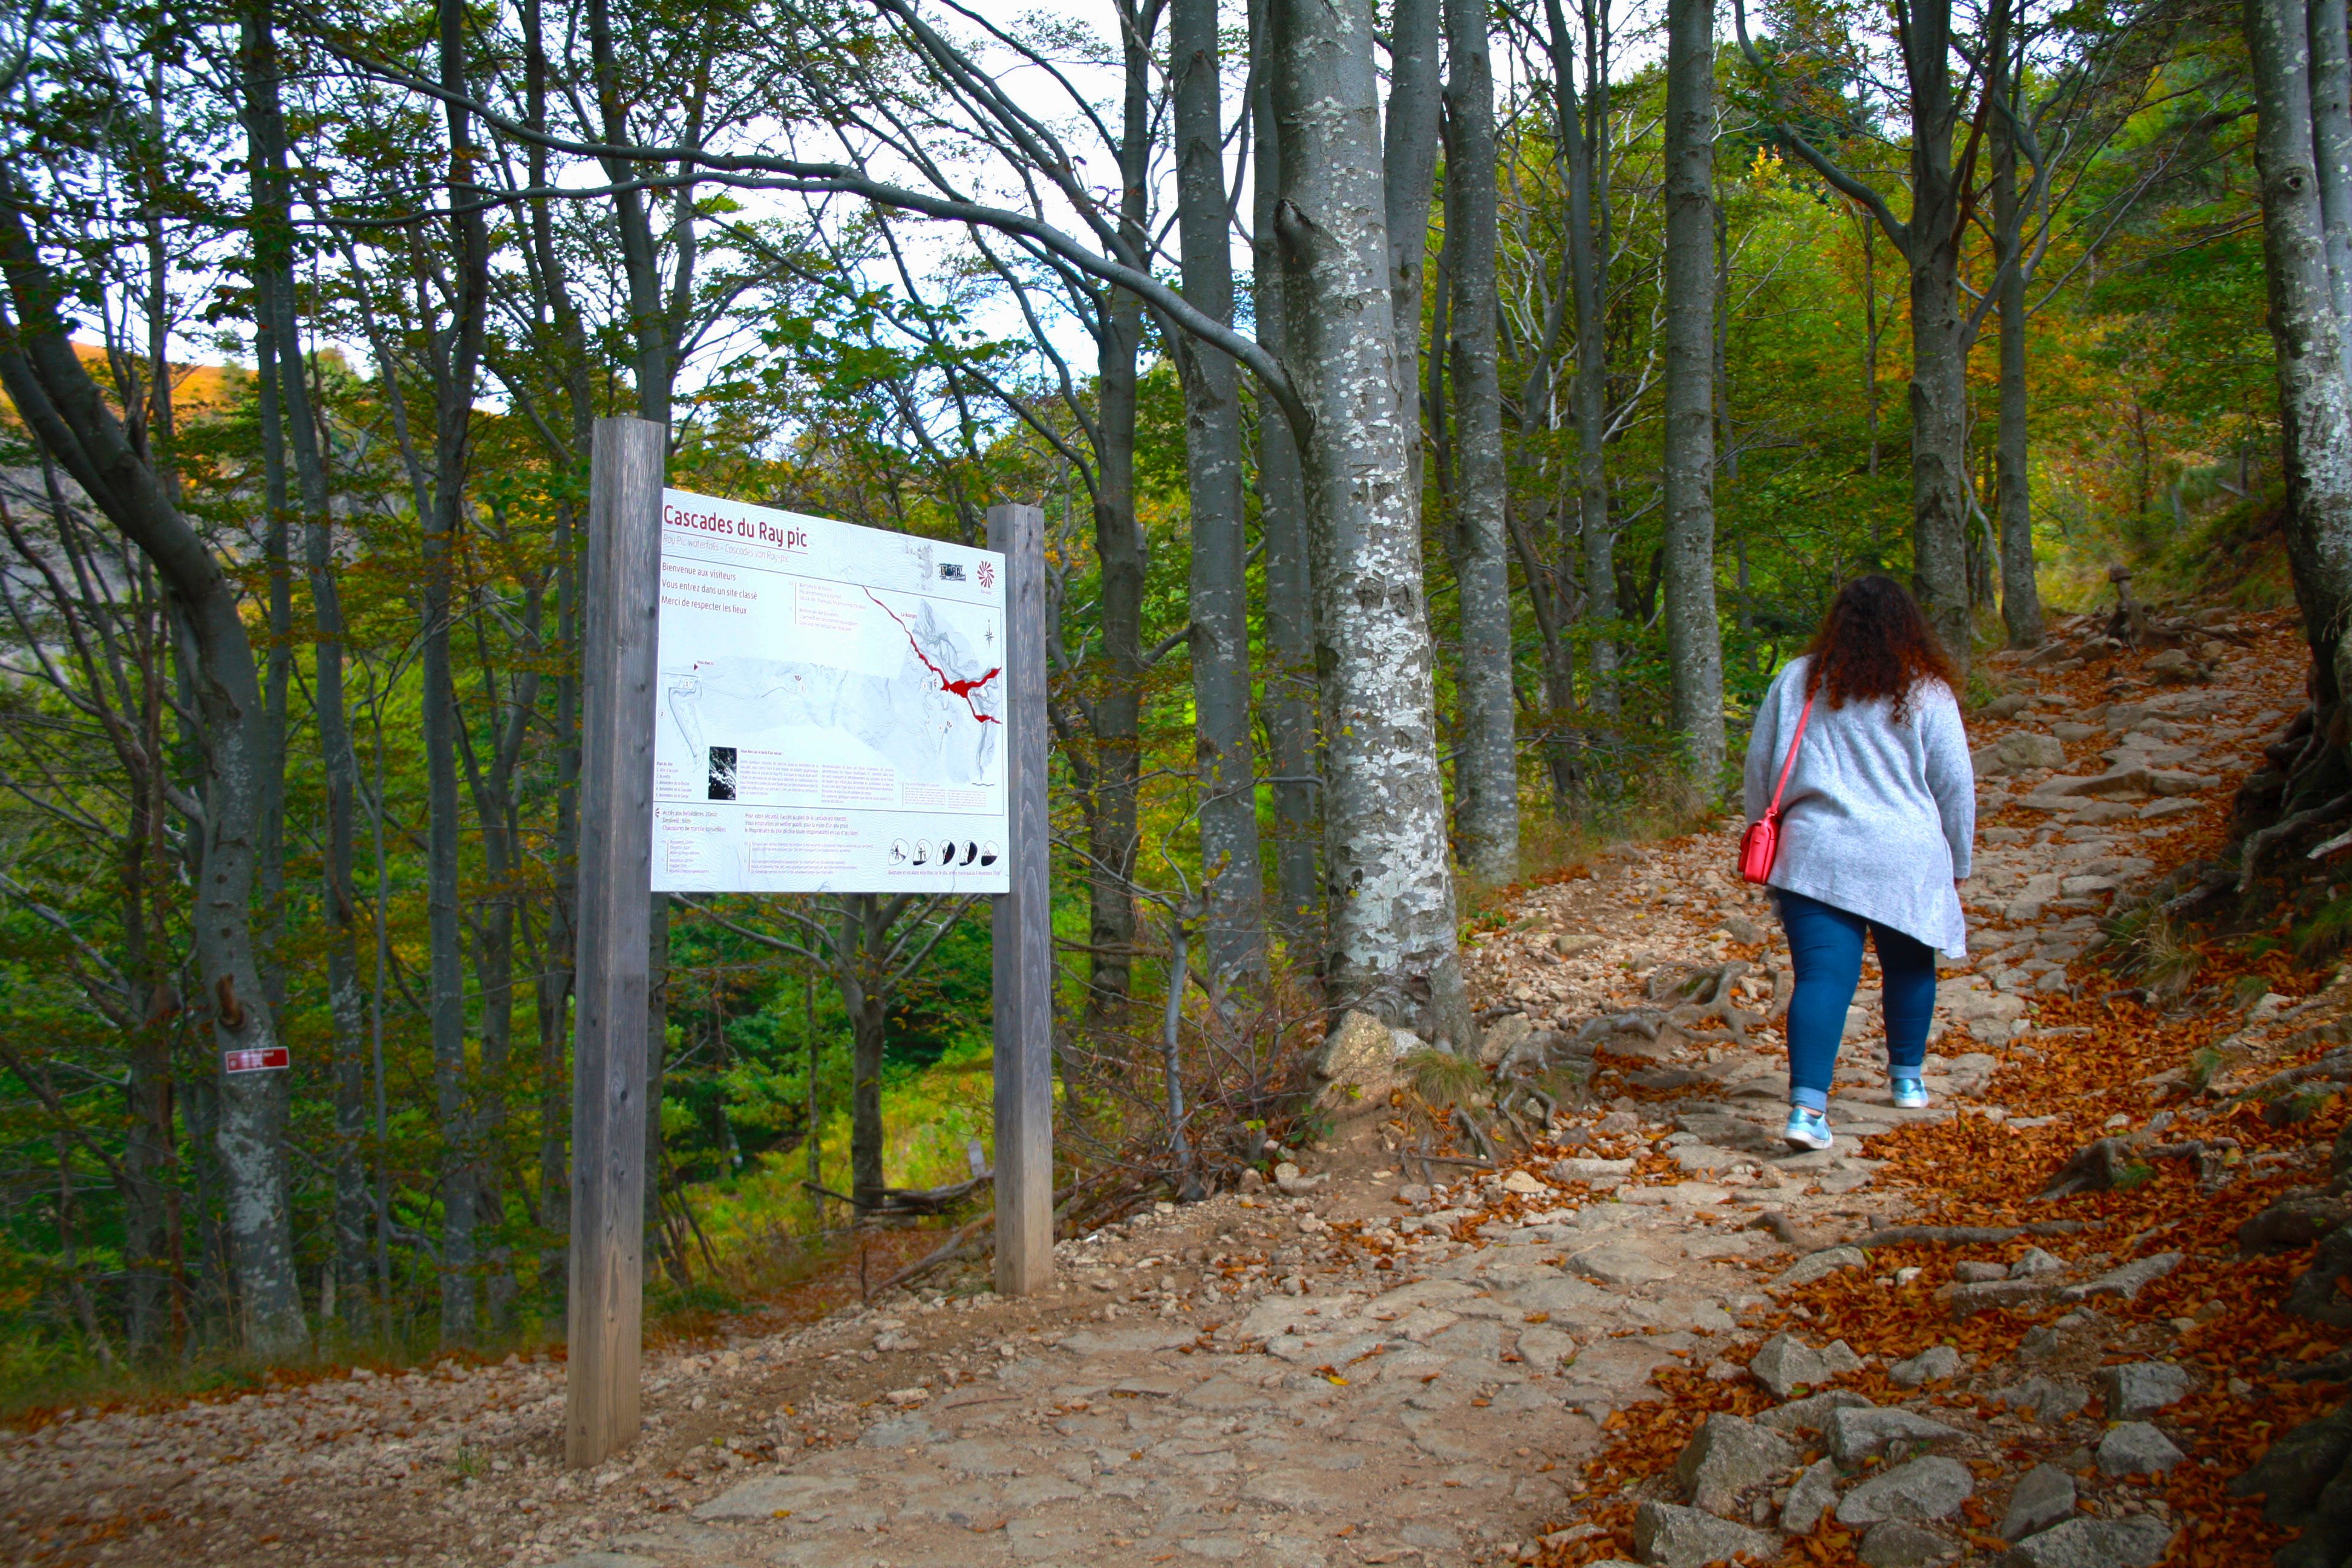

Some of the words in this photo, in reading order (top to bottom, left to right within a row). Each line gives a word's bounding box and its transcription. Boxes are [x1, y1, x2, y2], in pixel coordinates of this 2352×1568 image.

[664, 505, 733, 534] Cascades
[737, 517, 755, 538] du
[759, 521, 783, 547] Ray
[788, 526, 808, 549] pic
[662, 562, 696, 575] Bienvenue
[710, 569, 736, 581] visiteurs
[661, 578, 678, 589] Vous
[679, 581, 699, 592] entrez
[701, 583, 716, 595] dans
[727, 587, 737, 598] site
[739, 589, 757, 601] classé
[661, 595, 680, 606] Merci
[682, 598, 690, 607] de
[691, 599, 721, 613] respecter
[732, 605, 746, 615] lieux
